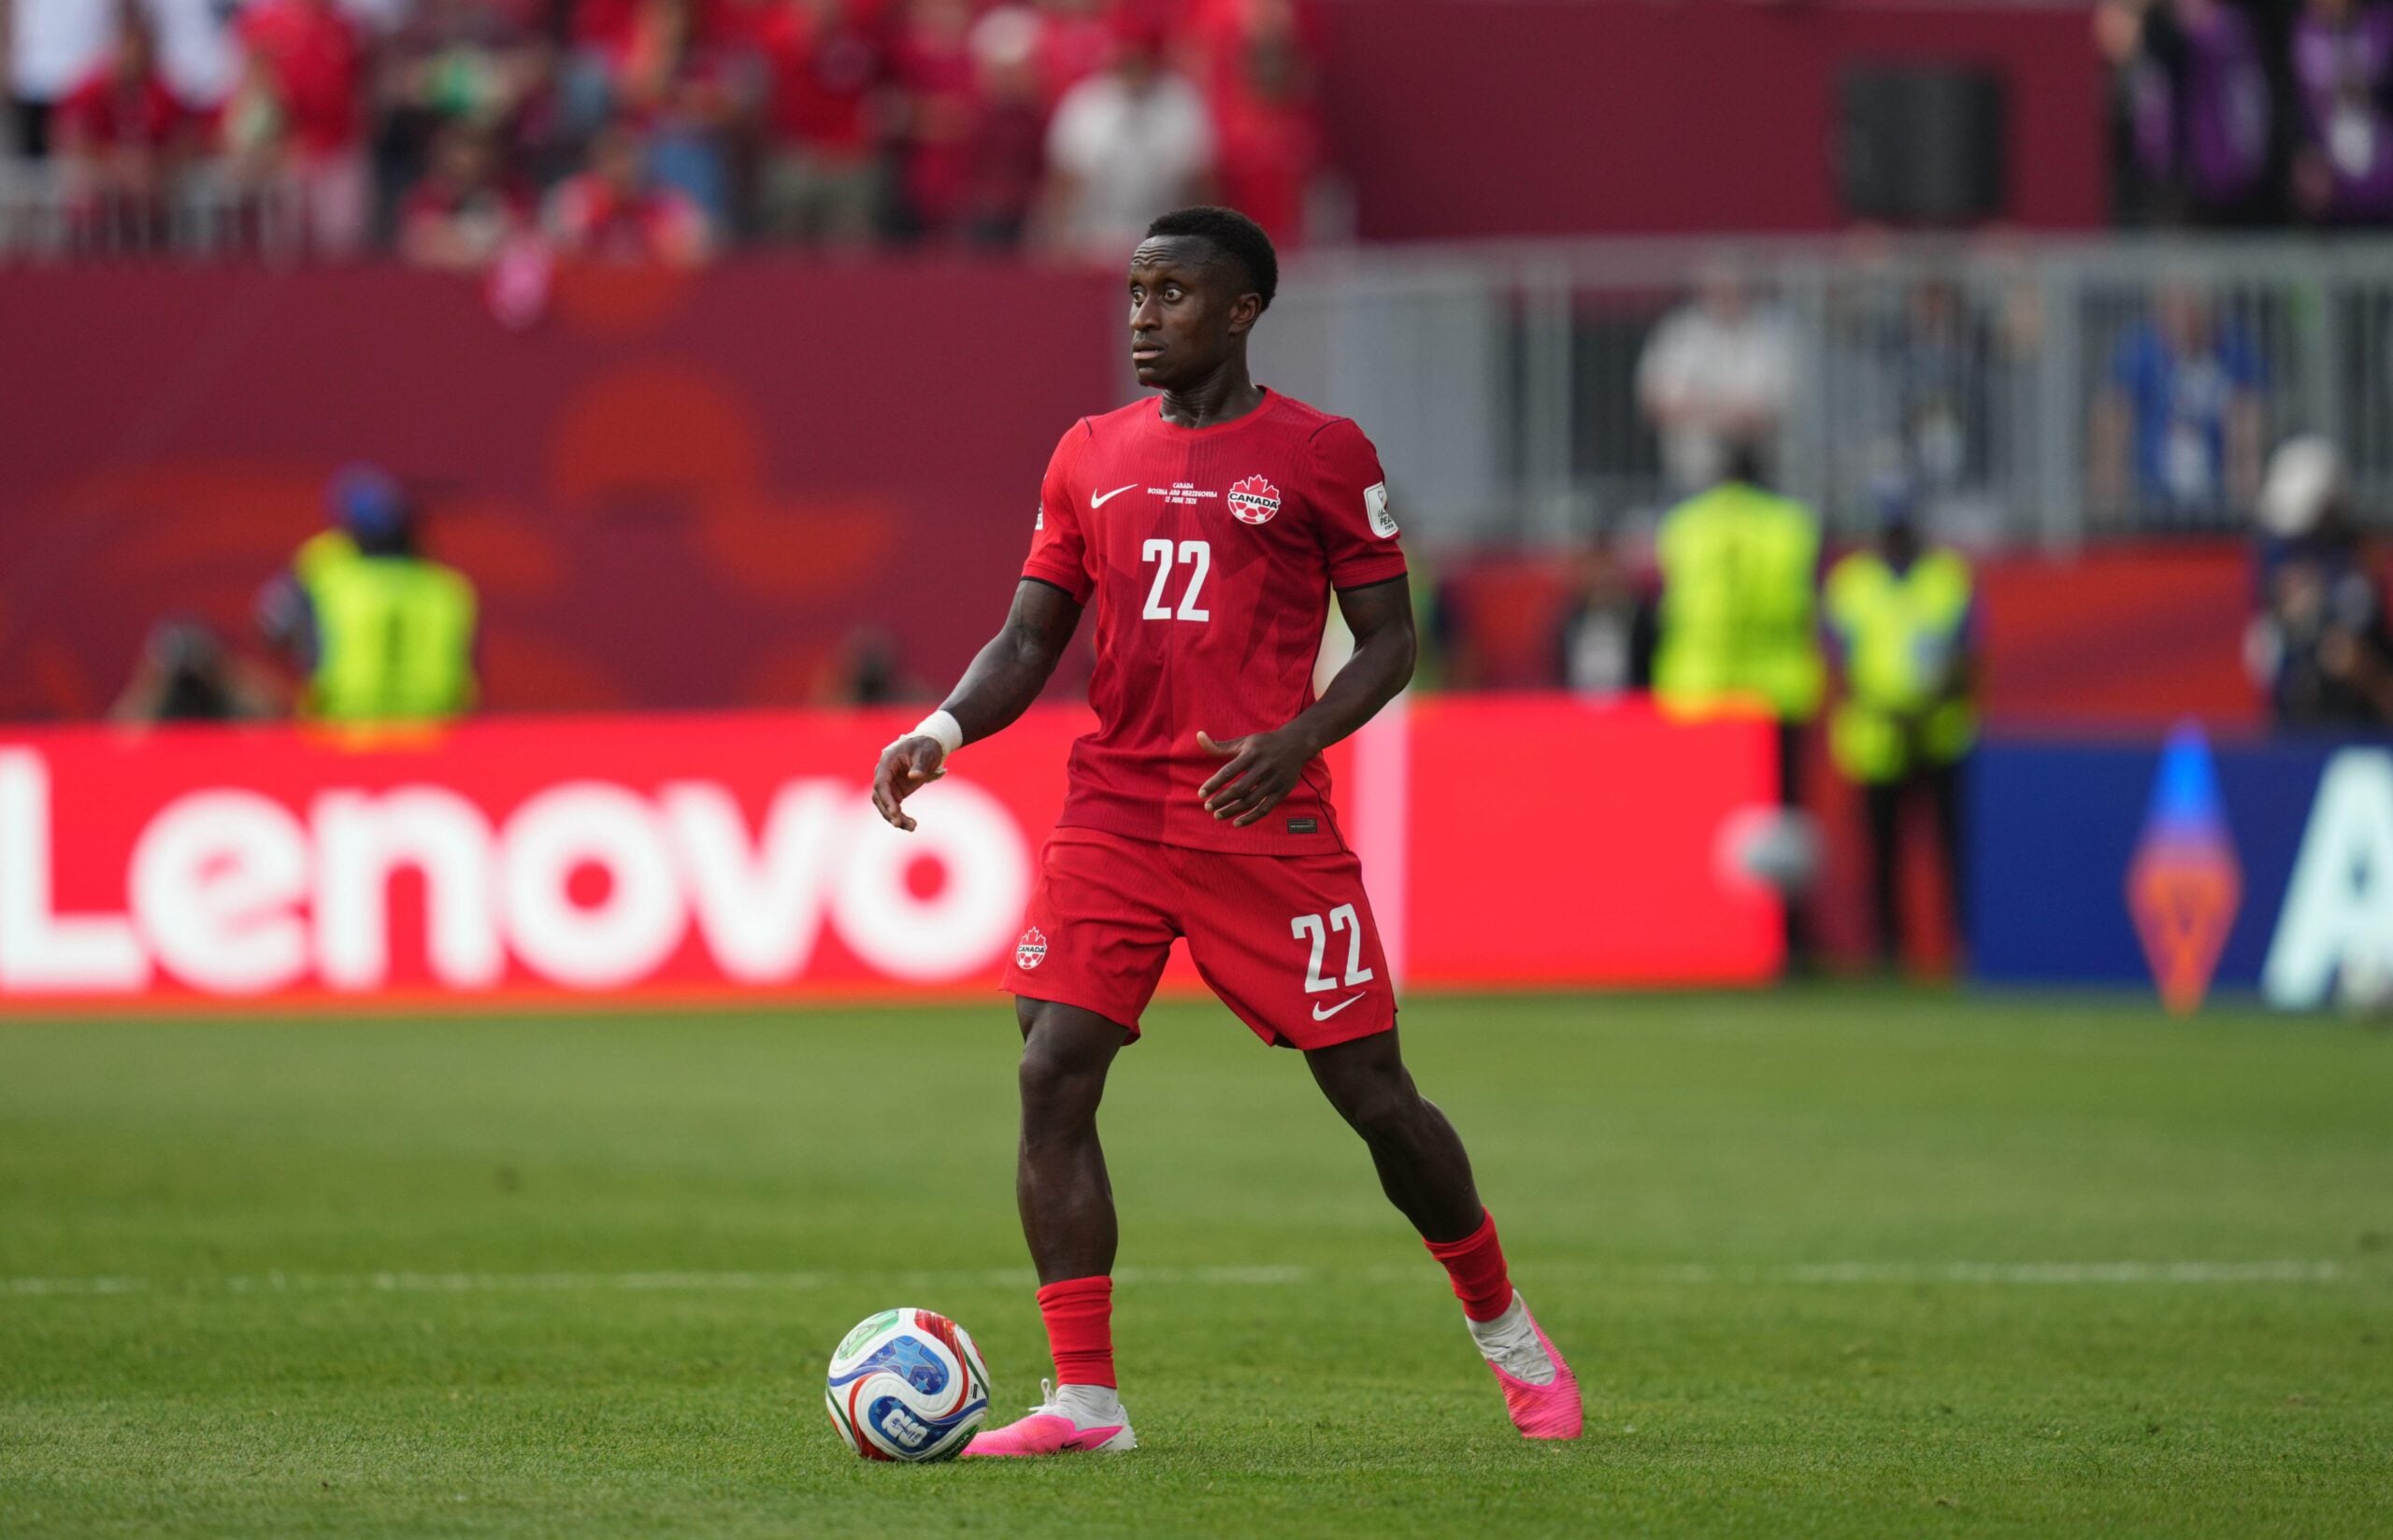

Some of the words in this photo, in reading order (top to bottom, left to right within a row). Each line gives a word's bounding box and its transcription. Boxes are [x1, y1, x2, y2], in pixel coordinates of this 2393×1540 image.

[1182, 490, 1218, 498] HERZEGOVINA
[1229, 492, 1278, 509] CANADA
[1142, 538, 1211, 621] 22
[0, 744, 1031, 994] Lenovo
[1290, 903, 1374, 993] 22
